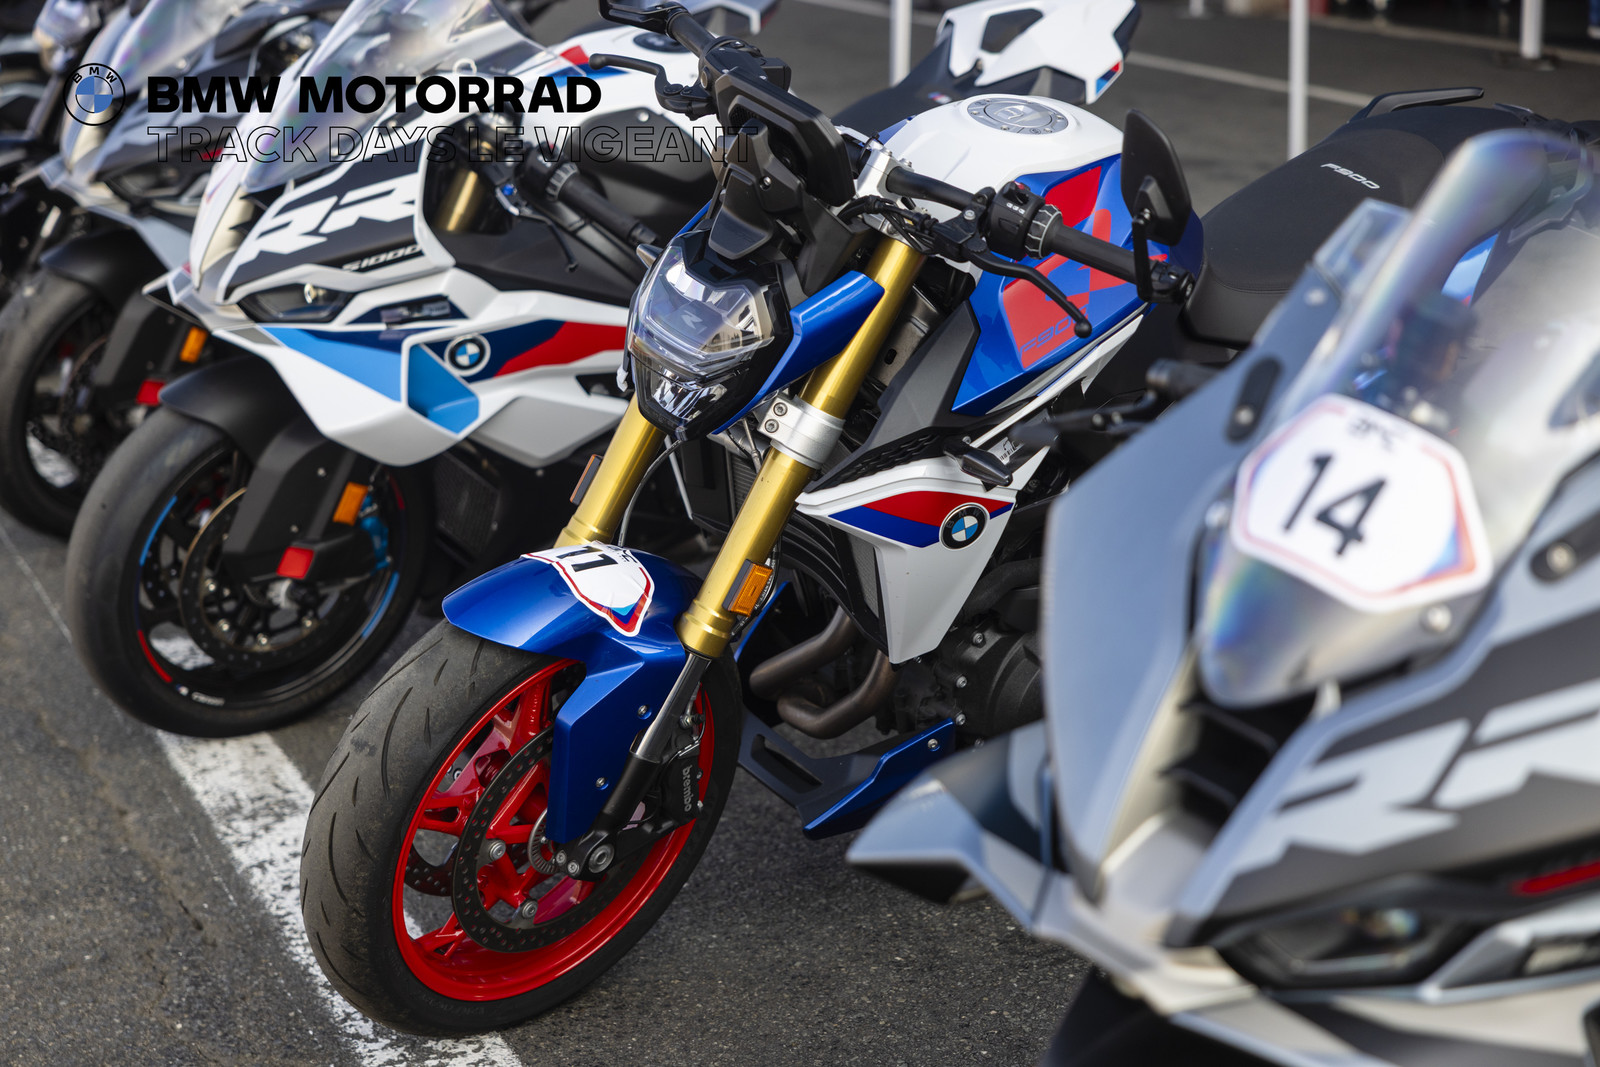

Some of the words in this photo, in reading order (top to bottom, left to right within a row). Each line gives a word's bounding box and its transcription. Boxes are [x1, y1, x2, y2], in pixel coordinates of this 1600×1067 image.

[1320, 163, 1380, 189] F900
[341, 243, 423, 271] S1000
[1283, 453, 1388, 557] 14
[682, 764, 694, 812] brembo
